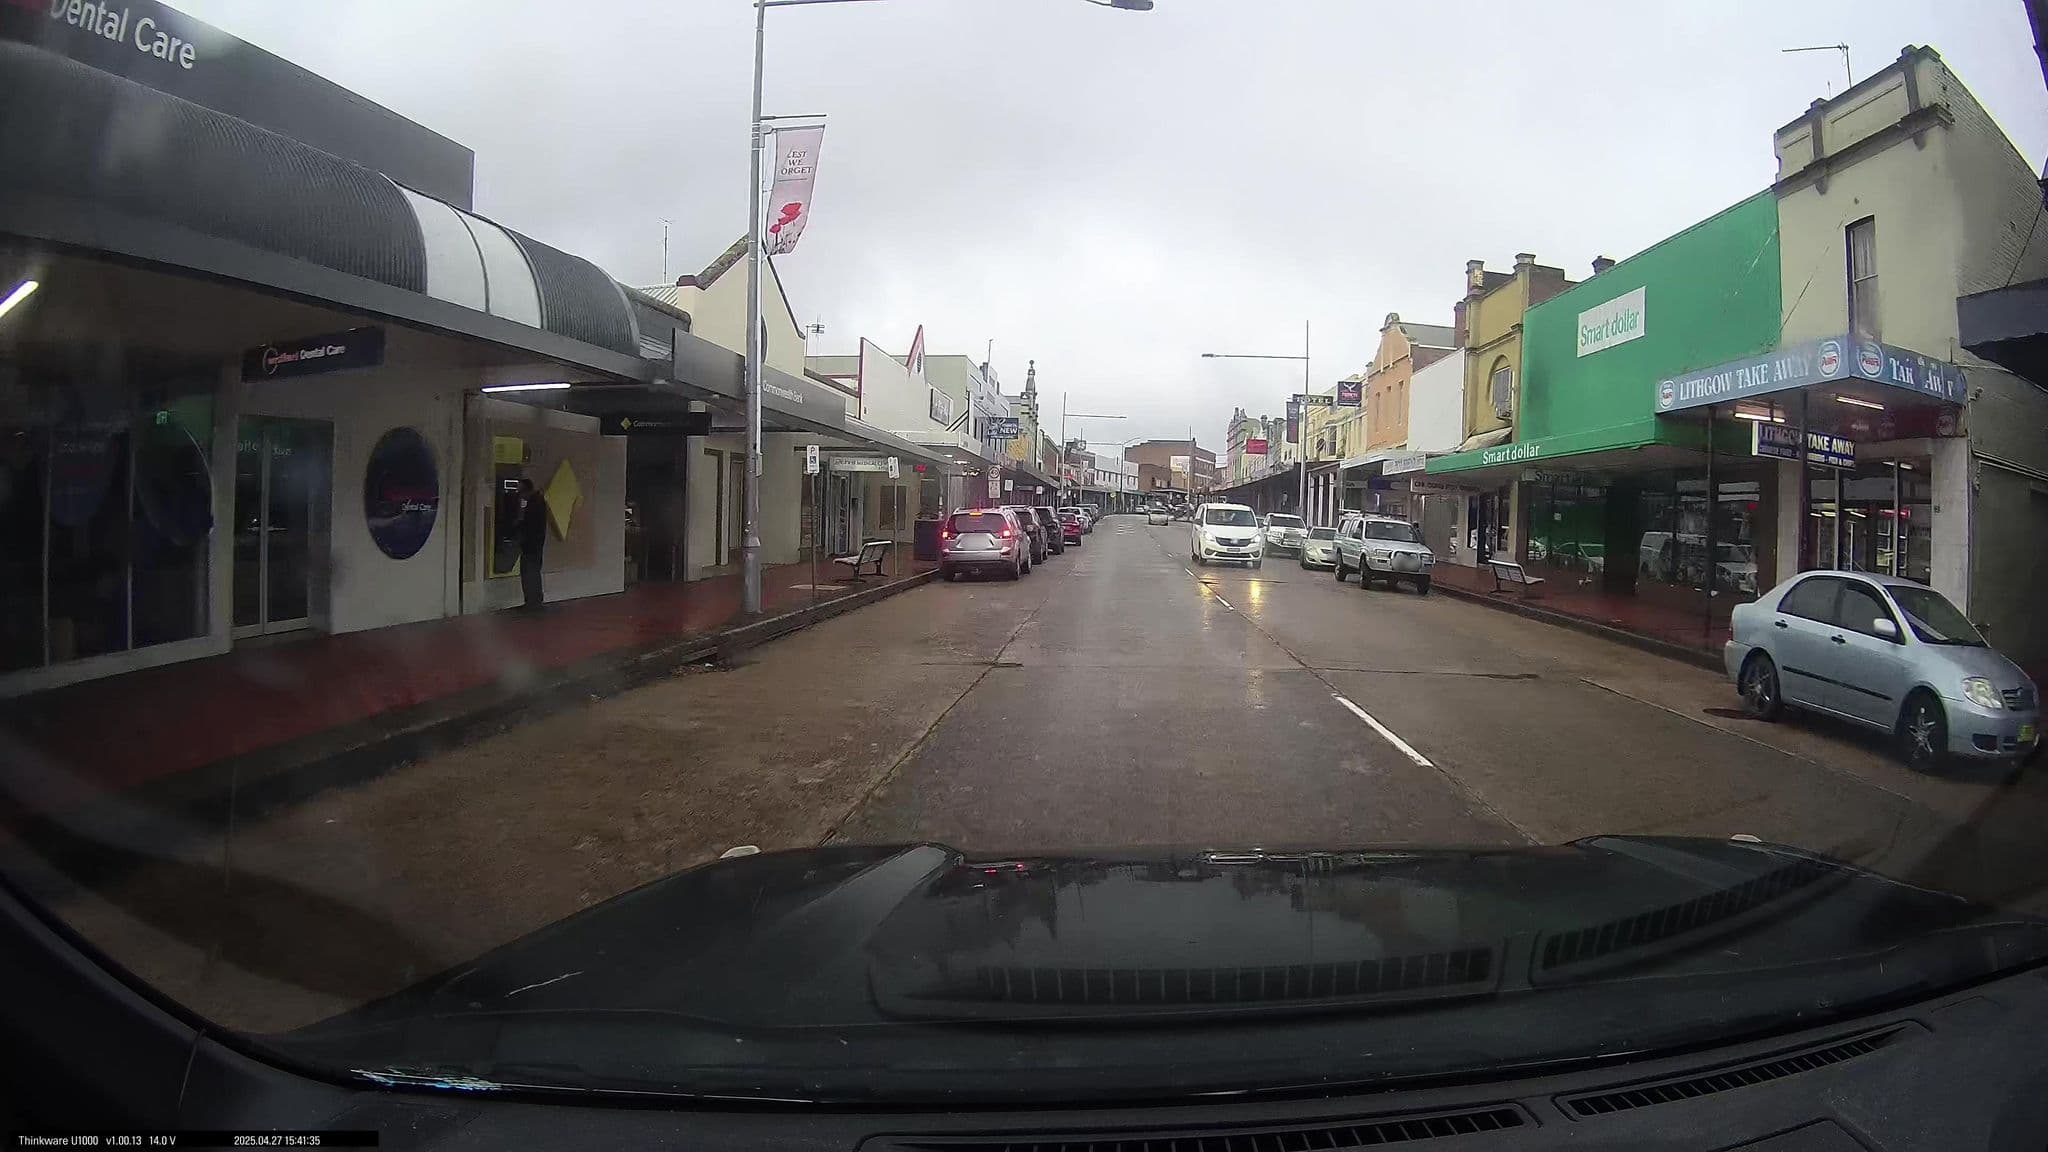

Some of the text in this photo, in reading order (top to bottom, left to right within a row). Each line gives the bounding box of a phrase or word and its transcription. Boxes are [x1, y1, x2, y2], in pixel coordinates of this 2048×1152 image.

[134, 17, 196, 70] Care
[781, 166, 813, 175] ORGET
[1580, 308, 1640, 347] Smart dollar
[1679, 371, 1734, 401] LITHGOW
[1735, 363, 1769, 389] TAKE
[1773, 352, 1812, 382] AWAY
[1482, 443, 1540, 465] Smart dollar
[1806, 433, 1830, 452] TAKE
[1831, 438, 1856, 456] AWAY
